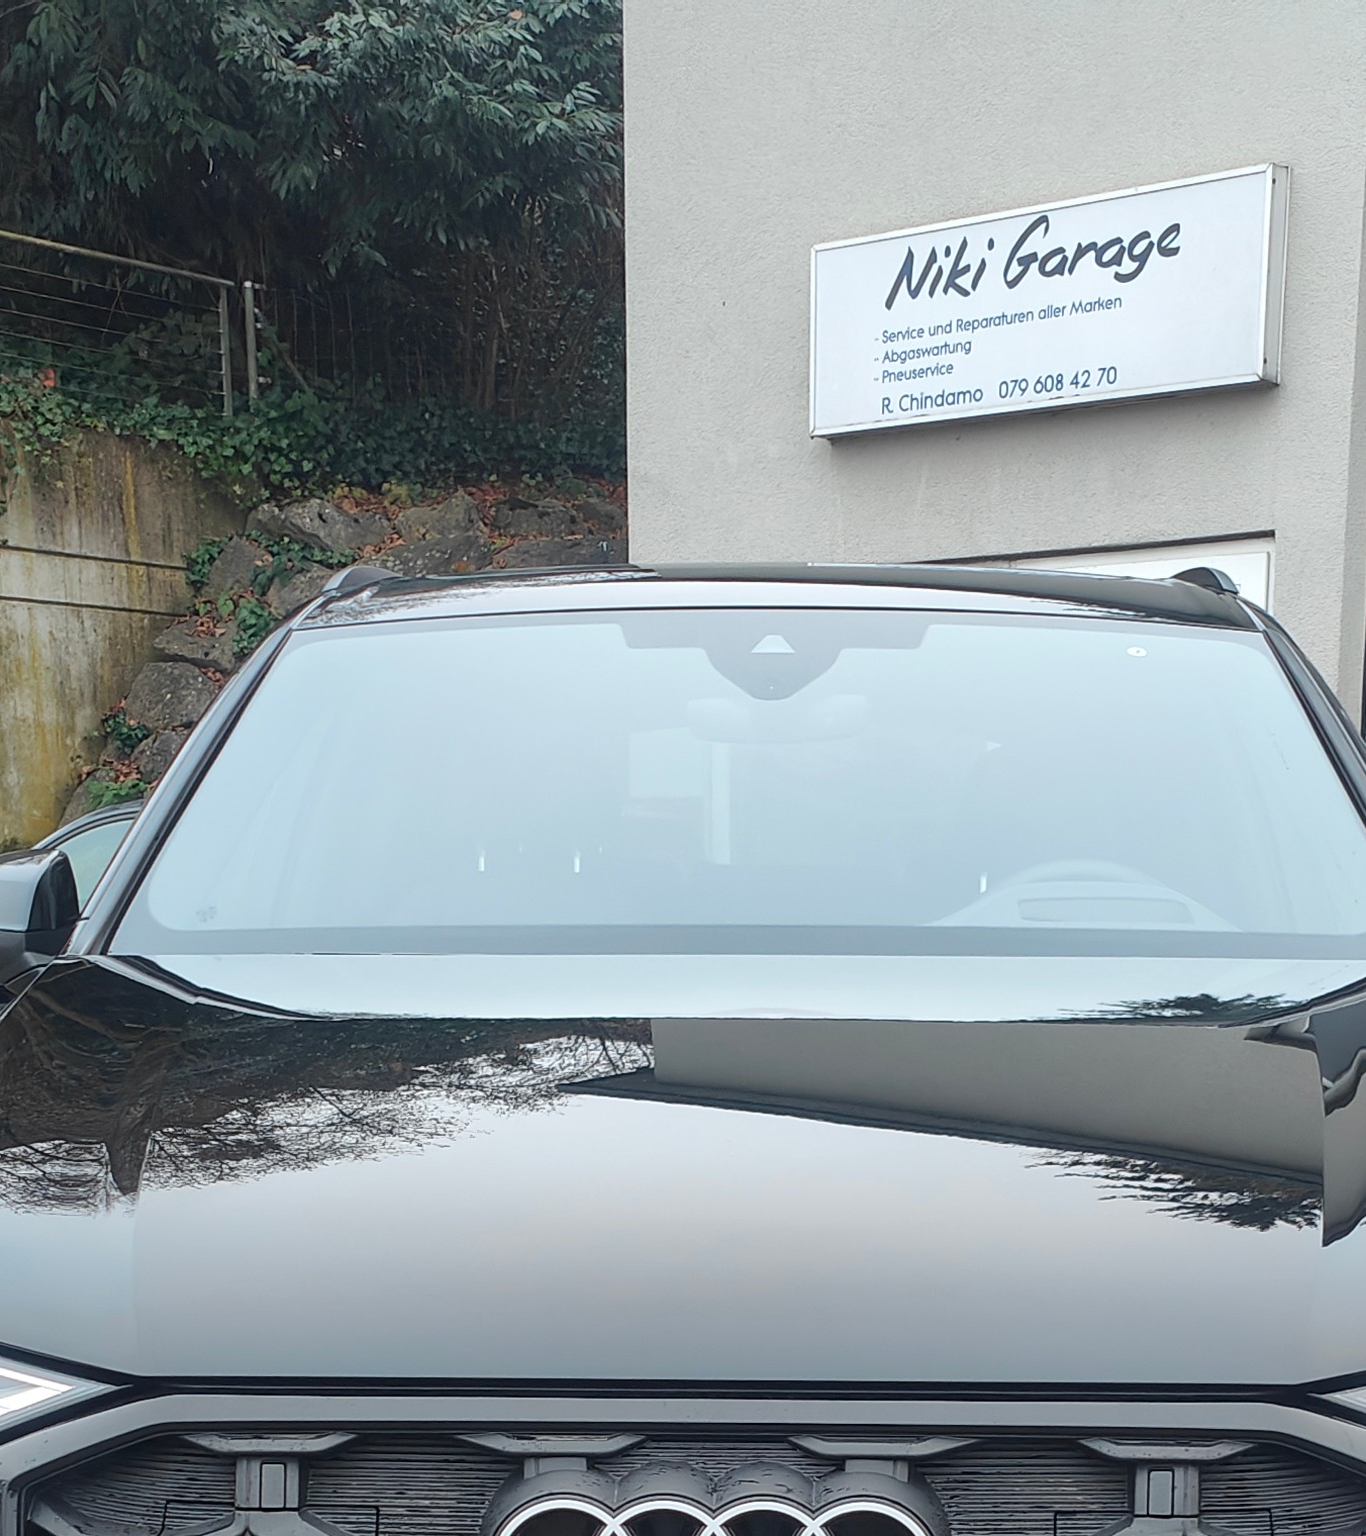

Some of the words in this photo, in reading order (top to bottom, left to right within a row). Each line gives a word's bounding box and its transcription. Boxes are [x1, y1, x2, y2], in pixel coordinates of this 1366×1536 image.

[884, 235, 995, 311] Niki
[1003, 215, 1181, 290] Garage
[882, 327, 925, 344] Service
[928, 319, 953, 337] und
[956, 311, 1034, 334] Reparaturen
[1038, 304, 1067, 320] aller
[1069, 296, 1123, 316] Marken
[881, 362, 954, 384] Pneuservice
[882, 340, 972, 364] Abgaswartung
[898, 388, 984, 412] Chindamo
[998, 377, 1029, 399] 079
[1033, 372, 1064, 395] 608
[1069, 369, 1091, 390] 42
[1096, 365, 1118, 387] 70
